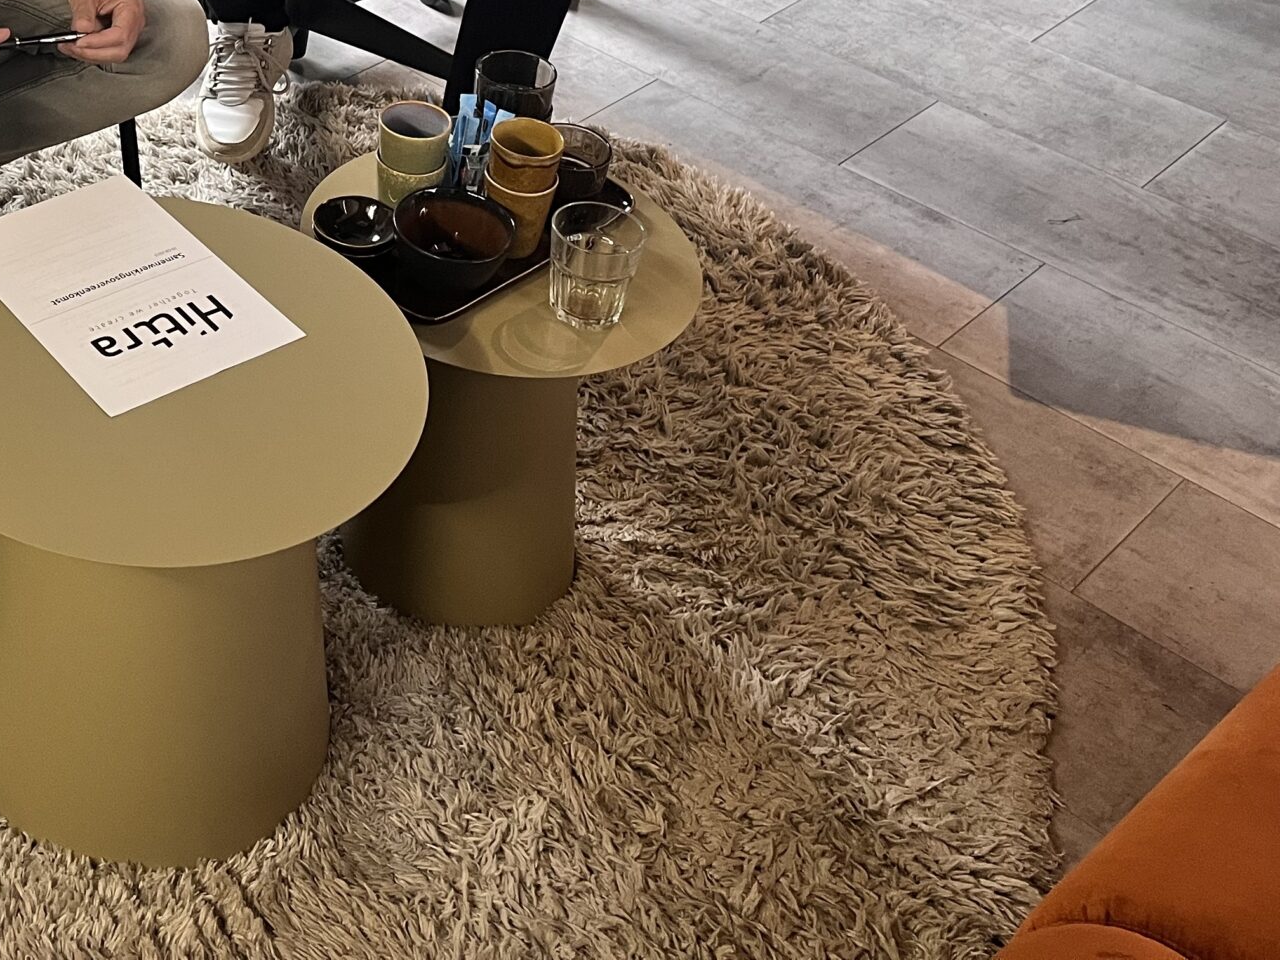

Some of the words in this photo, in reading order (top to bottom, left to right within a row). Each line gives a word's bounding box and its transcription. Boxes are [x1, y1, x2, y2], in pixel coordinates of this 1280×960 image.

[51, 252, 185, 306] Samenwerkingsovereenkomst
[88, 315, 124, 333] create
[90, 295, 233, 358] Hittra
[128, 307, 143, 319] we
